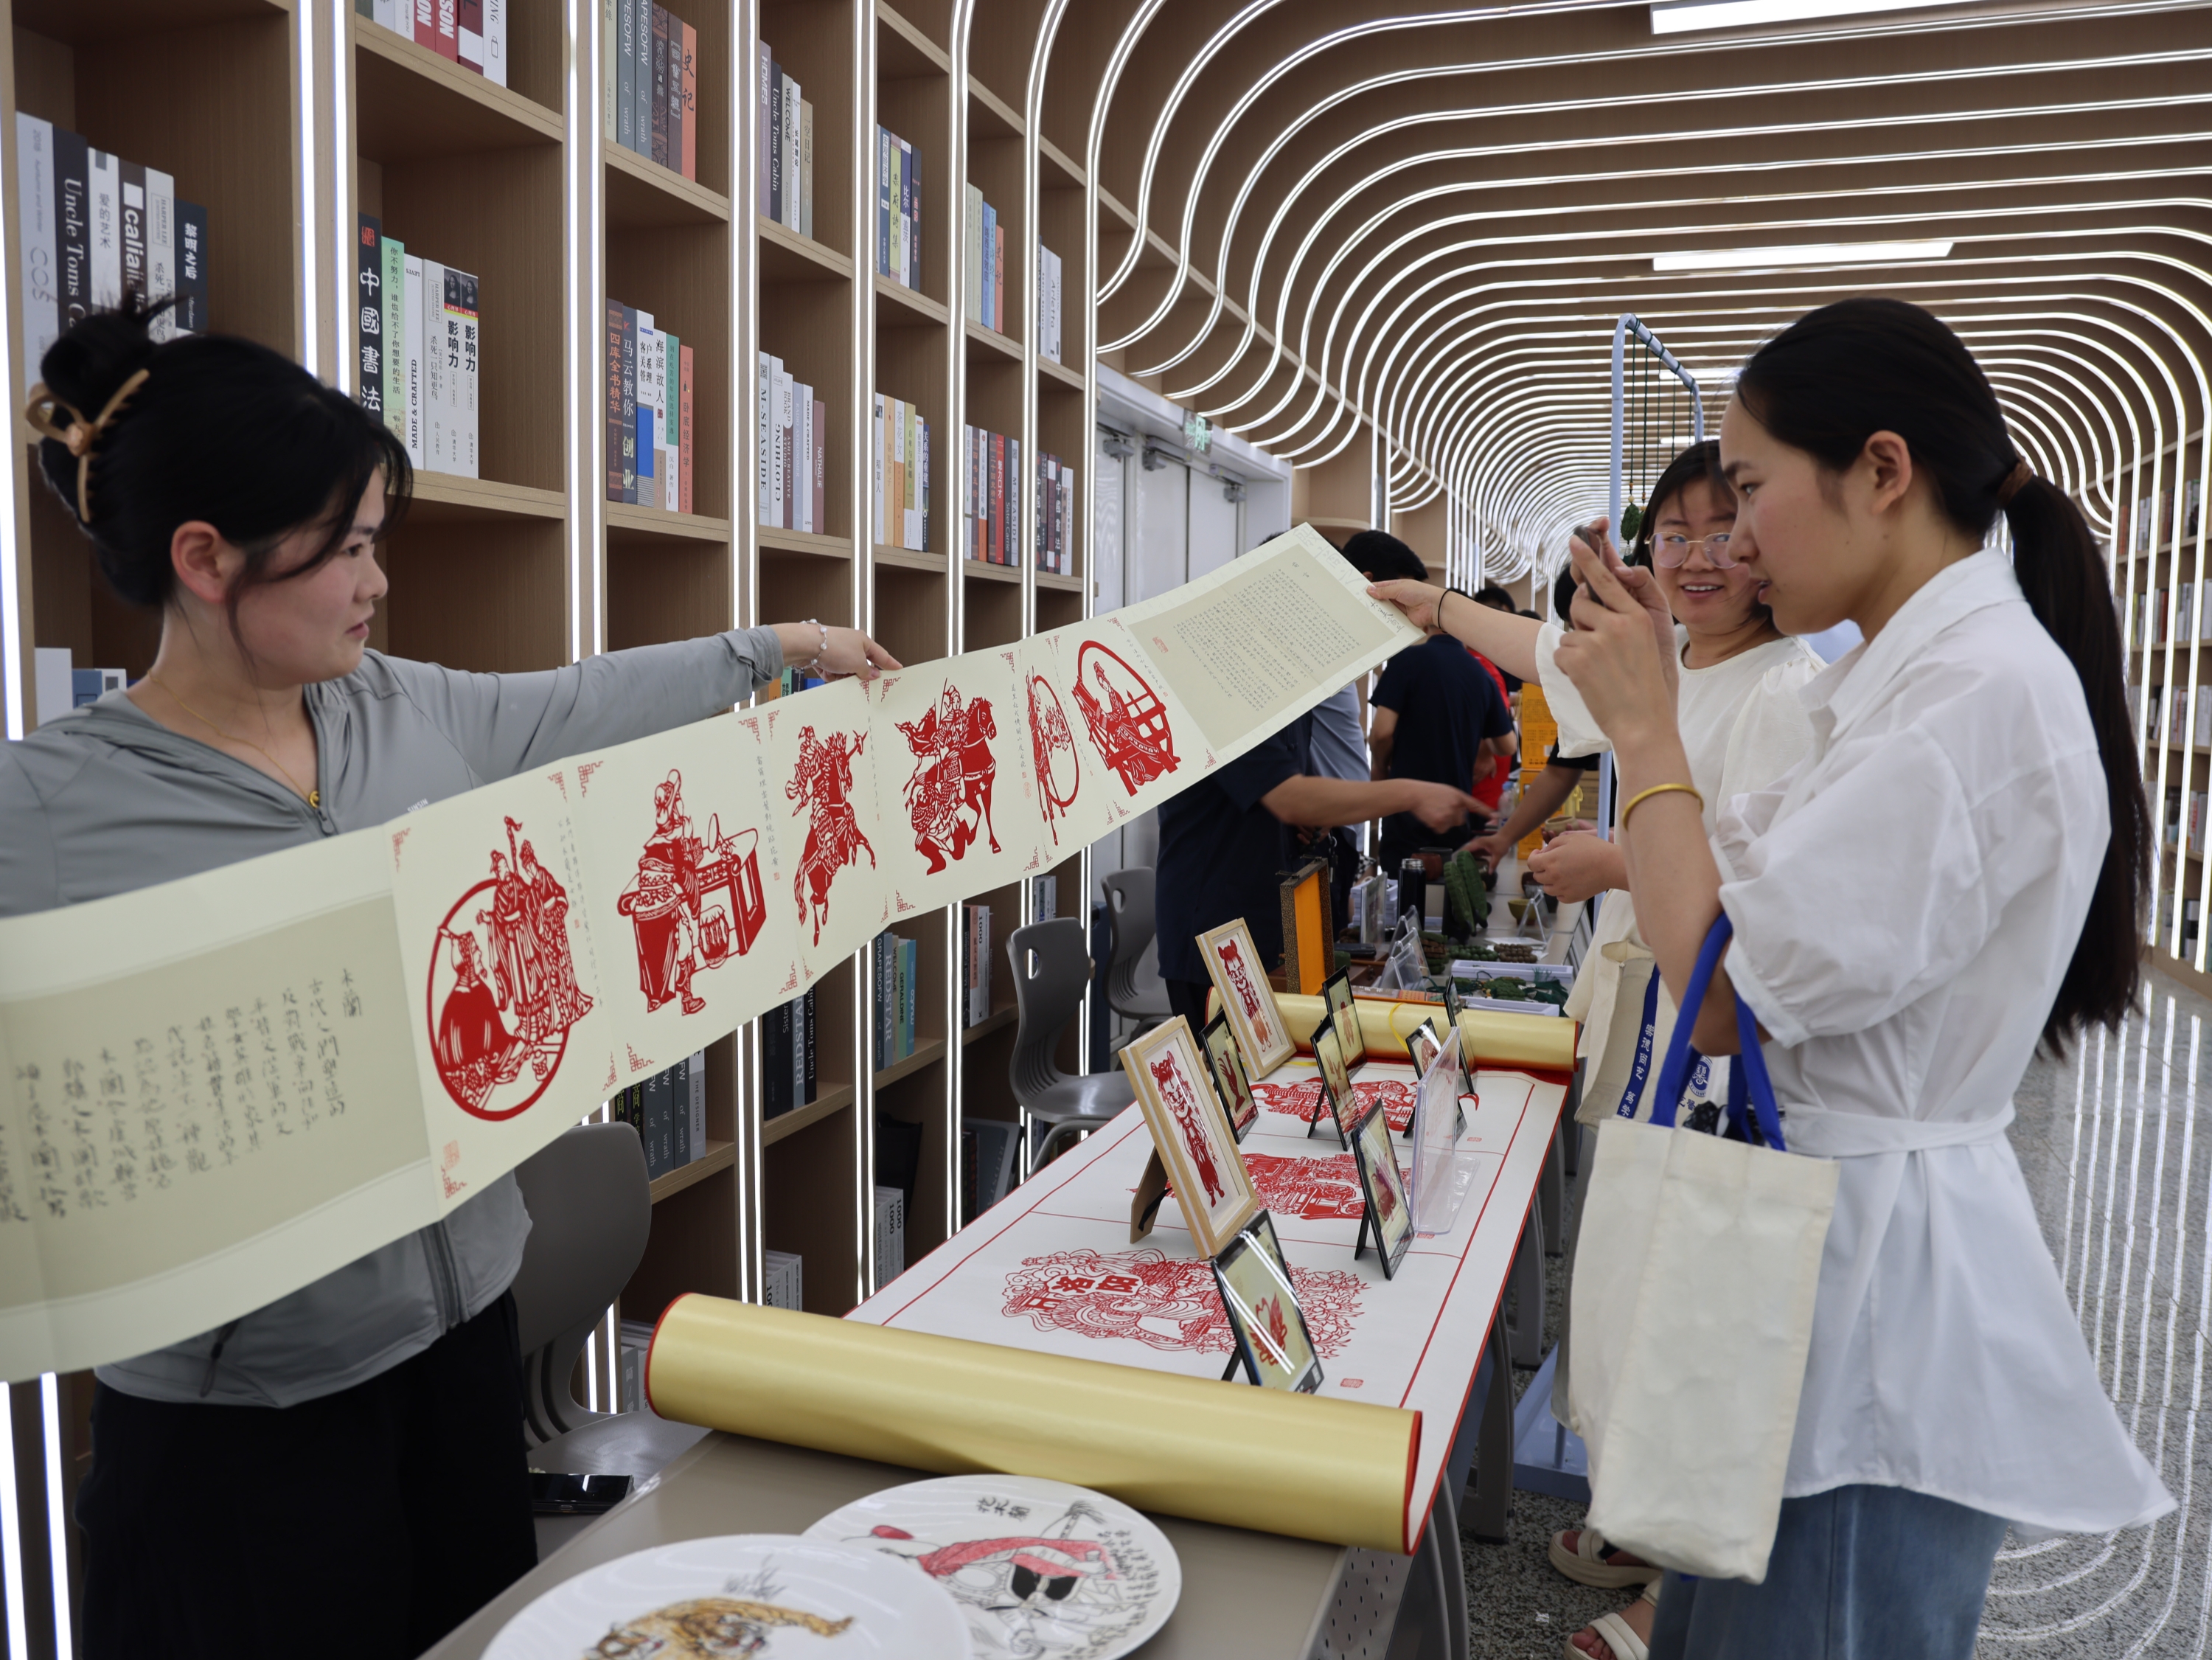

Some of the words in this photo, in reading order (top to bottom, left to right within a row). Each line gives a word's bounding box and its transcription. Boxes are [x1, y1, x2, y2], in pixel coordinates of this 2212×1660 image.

[625, 82, 631, 96] of
[641, 90, 647, 105] of
[65, 178, 84, 236] Uncle
[99, 192, 111, 249] 爱的艺术
[66, 244, 85, 296] Toms
[360, 267, 381, 412] 中國書法
[448, 320, 459, 369] 影响力
[465, 324, 476, 372] 影响力
[639, 340, 653, 355] 客户
[639, 356, 653, 370] 关系
[430, 335, 439, 400] 杀死一只知更鸟
[610, 332, 621, 414] 四库全书精华
[622, 338, 634, 417] 马云教你
[639, 369, 653, 384] 管理
[655, 338, 664, 404] 海滨故人
[411, 408, 418, 417] &
[622, 435, 634, 490] 创业
[407, 798, 428, 813] SINSIN
[341, 968, 362, 1018] 木蘭
[650, 1117, 655, 1128] of
[663, 1111, 669, 1121] of
[679, 1105, 686, 1115] of
